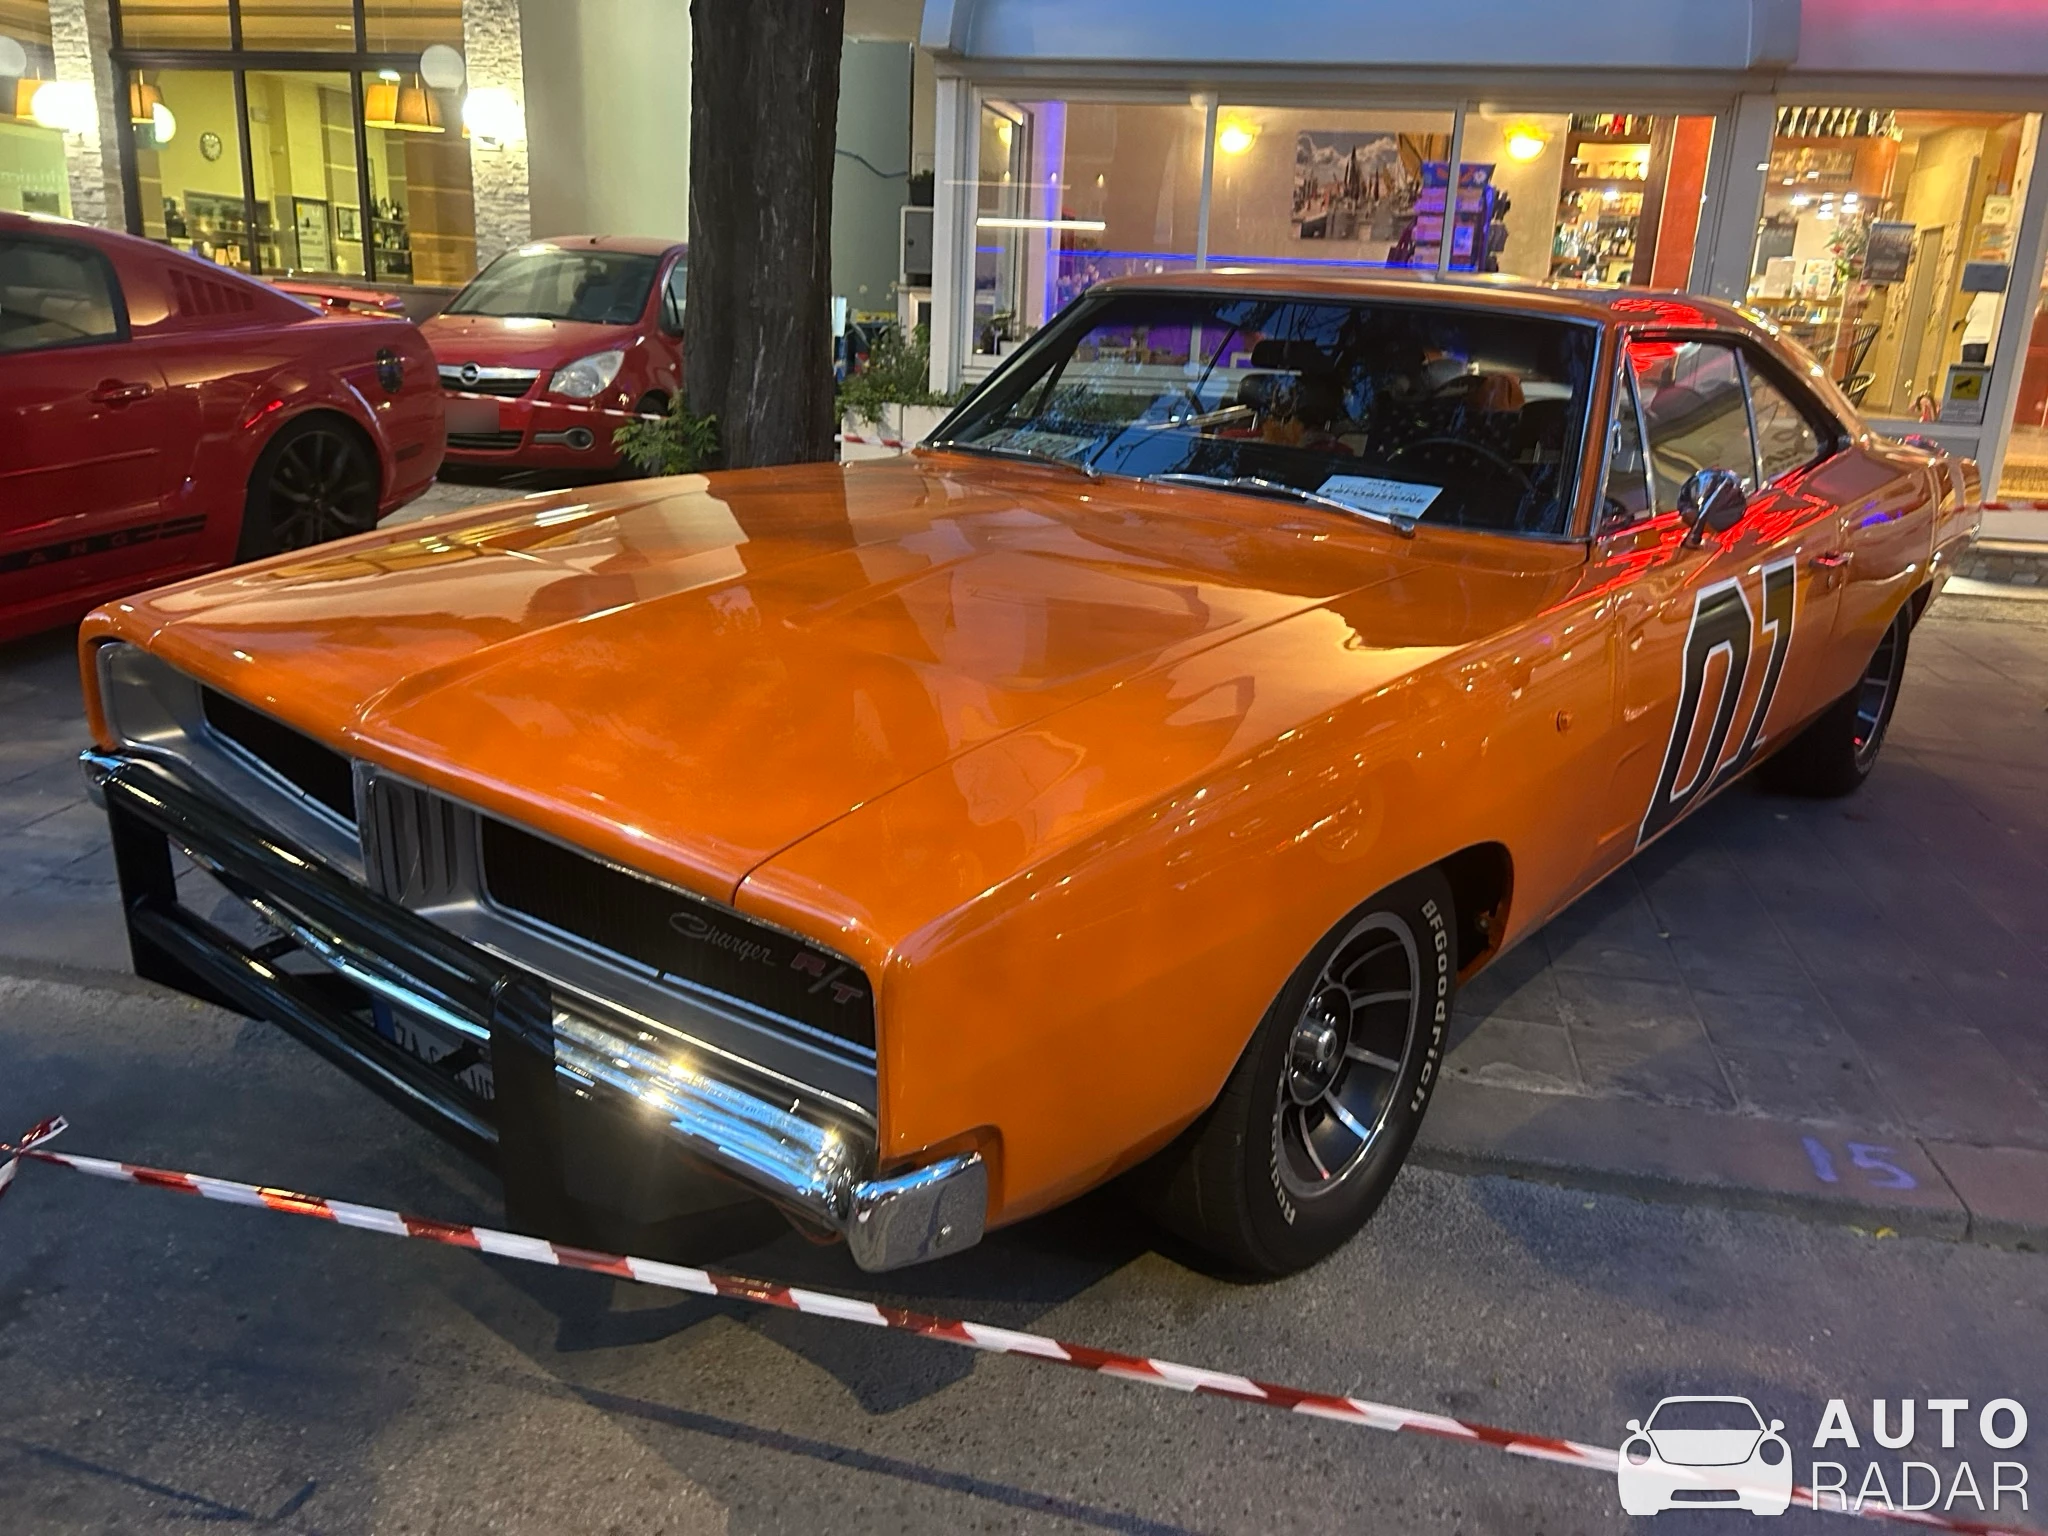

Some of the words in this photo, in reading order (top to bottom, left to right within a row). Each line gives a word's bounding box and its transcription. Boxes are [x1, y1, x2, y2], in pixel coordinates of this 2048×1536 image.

[1634, 555, 1796, 852] 01
[669, 911, 776, 967] Charger
[790, 951, 864, 1005] R/T
[1411, 899, 1448, 1112] BFGoodrich
[1801, 1136, 1918, 1190] 15
